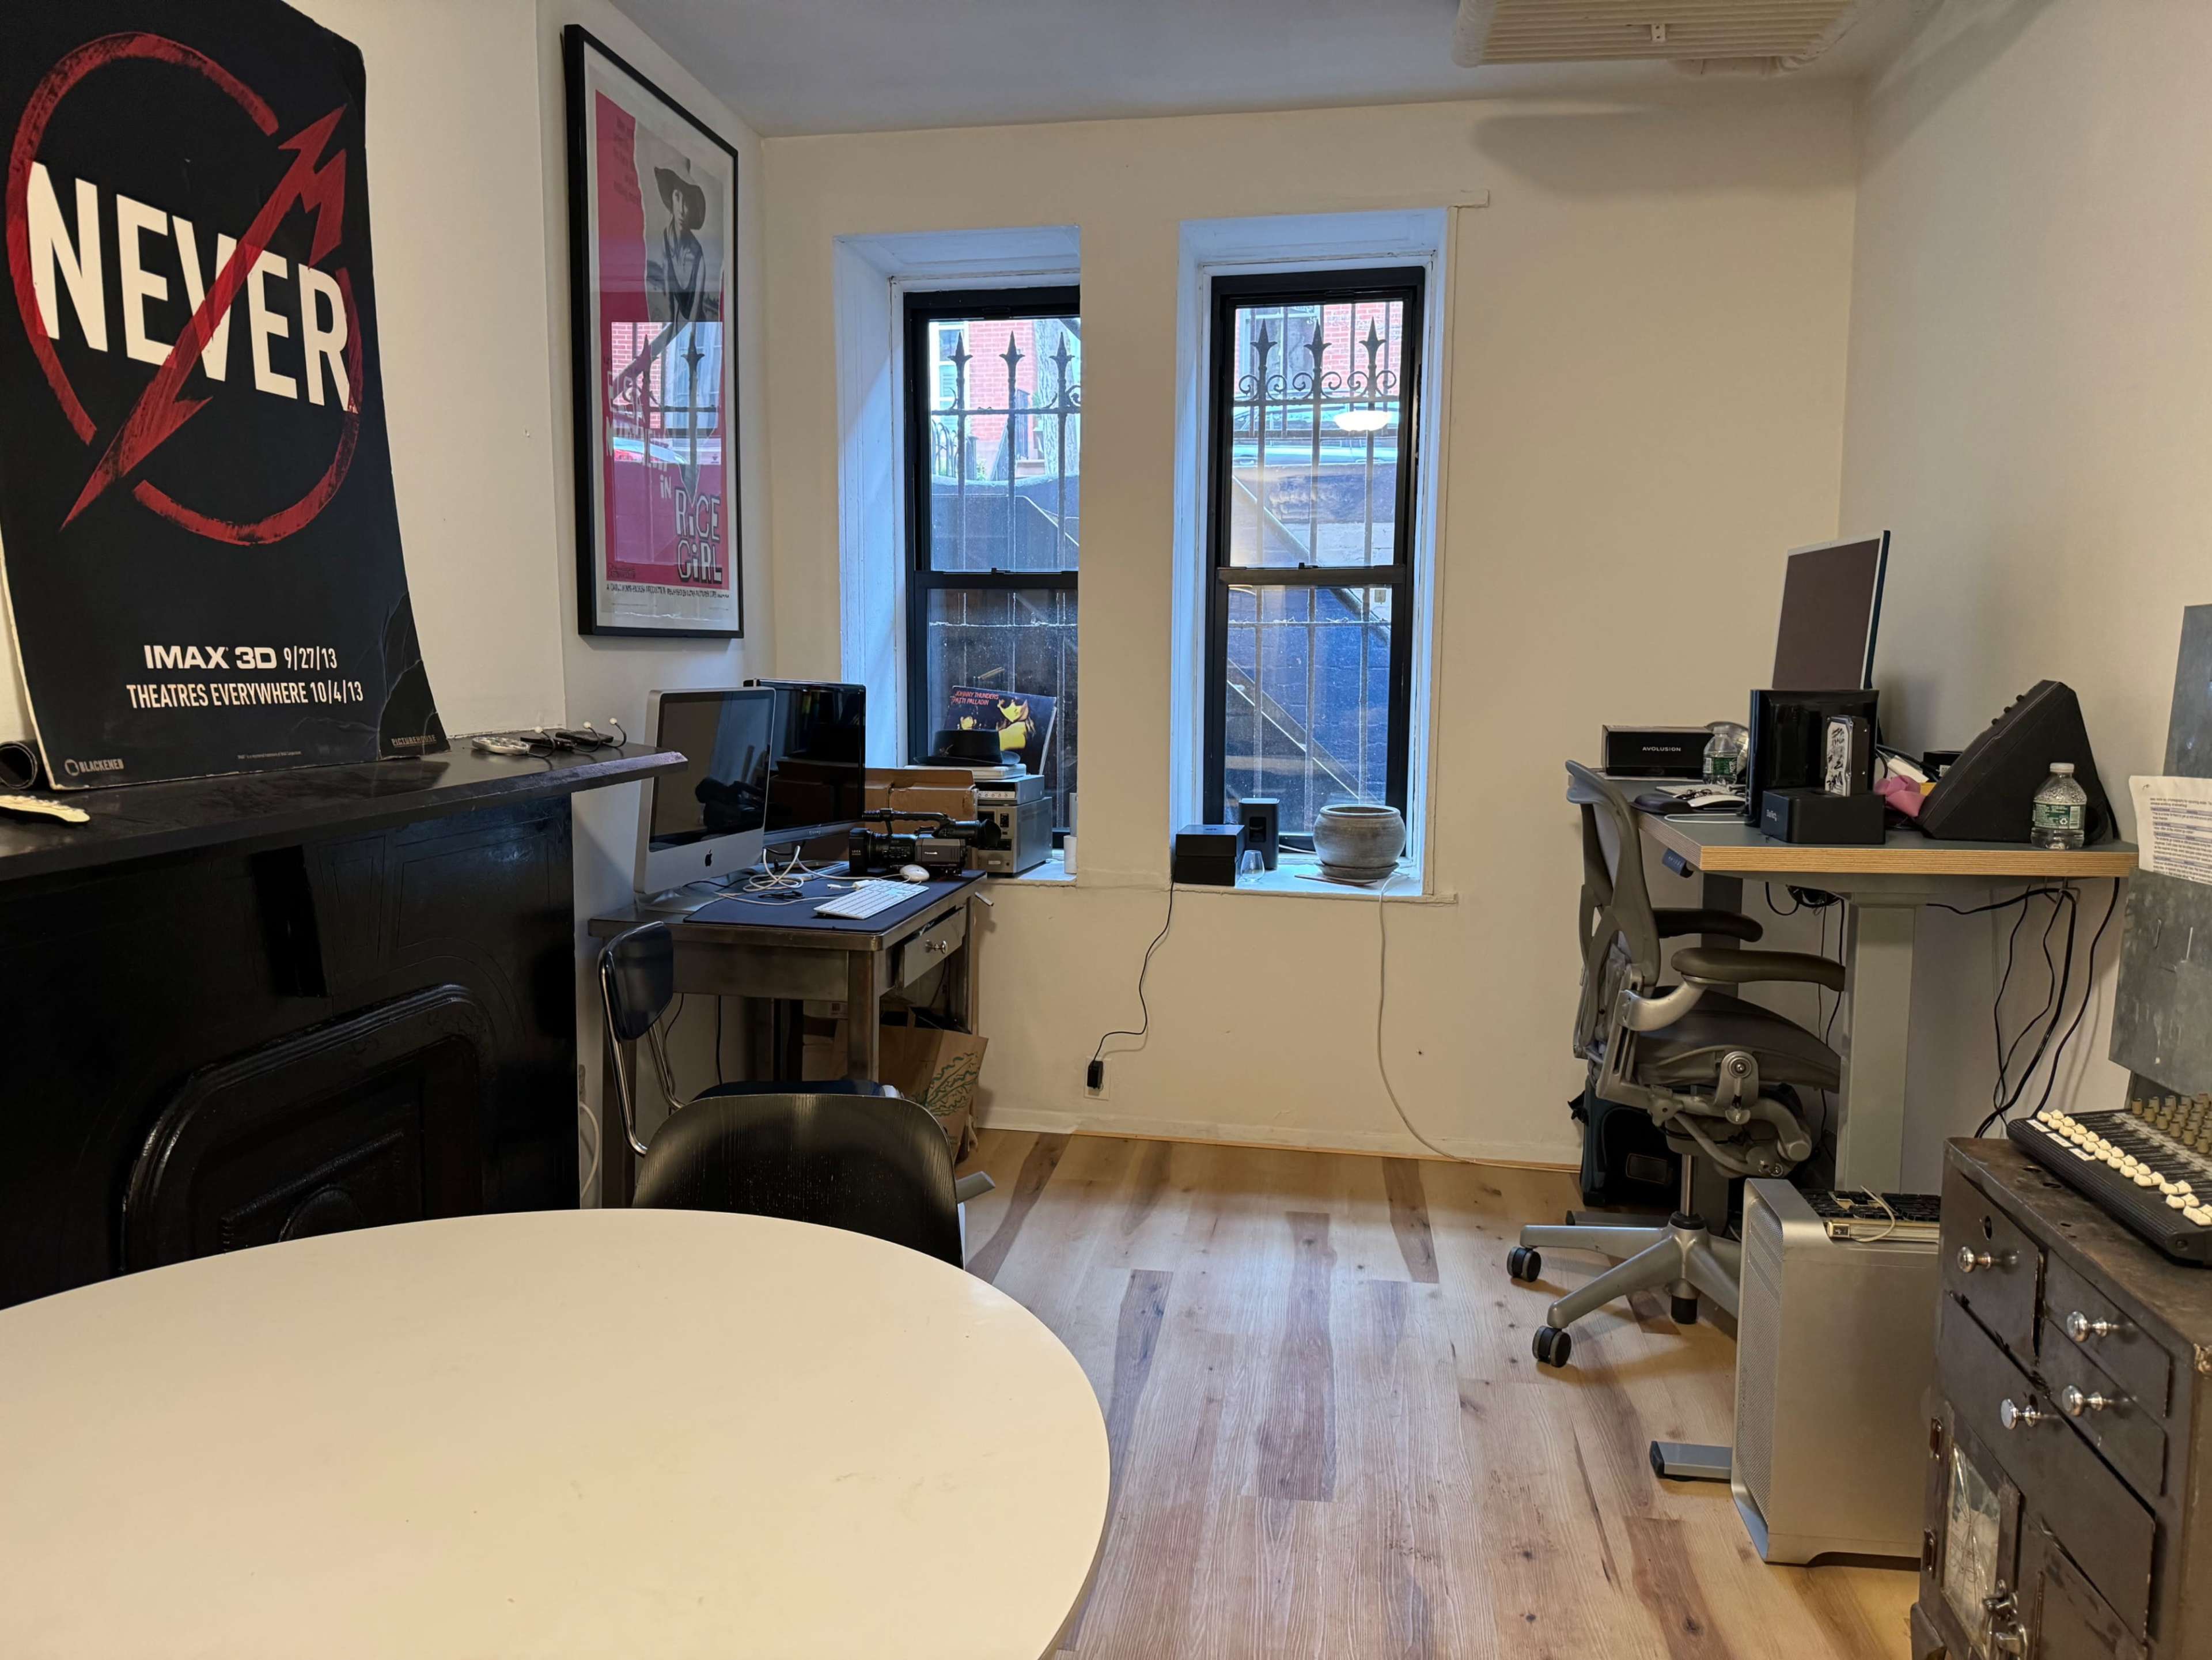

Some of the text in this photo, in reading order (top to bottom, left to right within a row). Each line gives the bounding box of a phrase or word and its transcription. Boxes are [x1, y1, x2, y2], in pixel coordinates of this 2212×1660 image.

[26, 160, 358, 414] NEVER
[234, 646, 277, 669] 3D
[126, 684, 209, 709] THEATRES
[210, 682, 309, 706] EVERYWHERE
[391, 735, 438, 747] PICTUREHOUSE
[78, 758, 124, 773] BLACKENED
